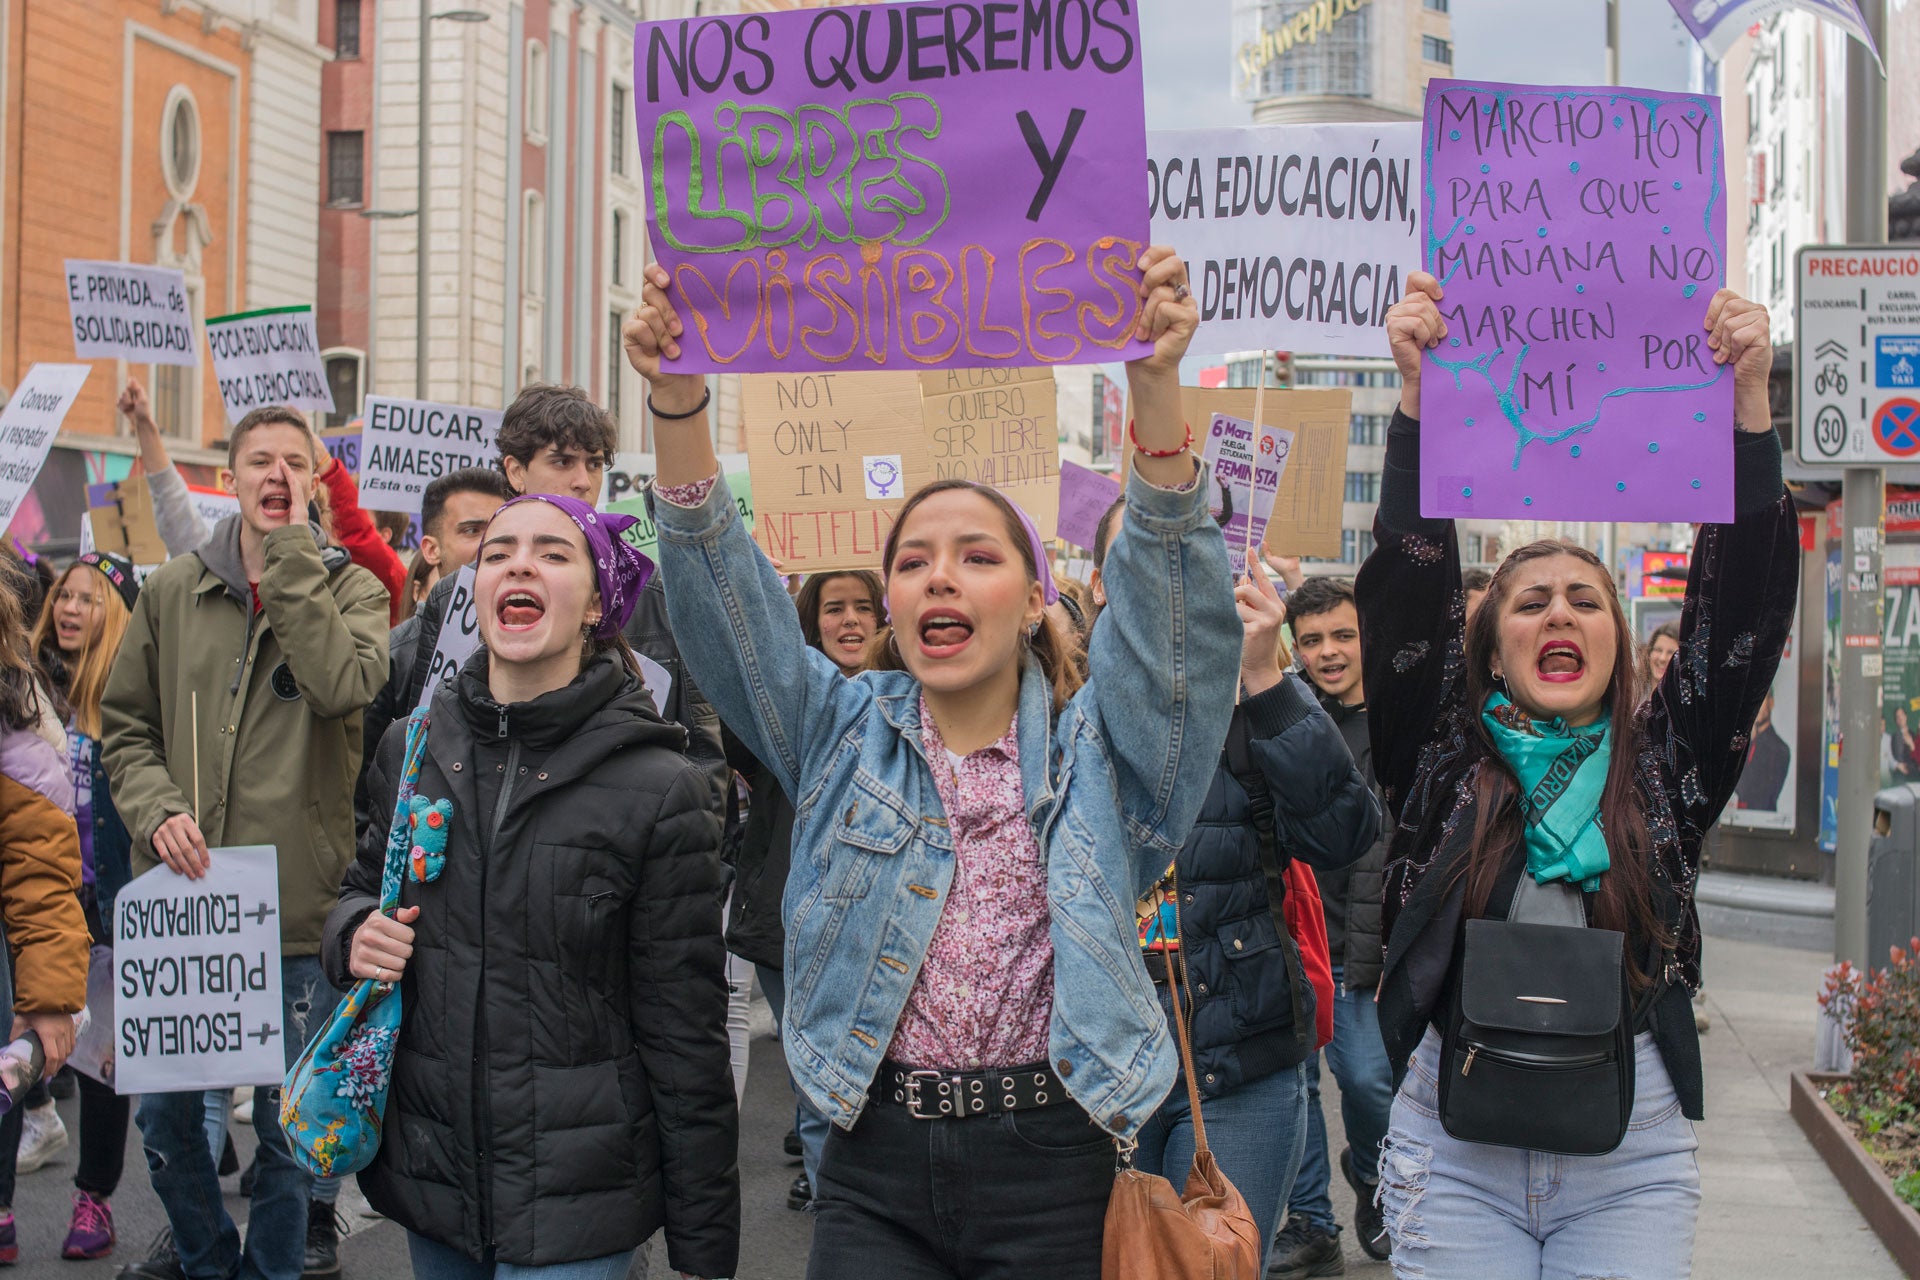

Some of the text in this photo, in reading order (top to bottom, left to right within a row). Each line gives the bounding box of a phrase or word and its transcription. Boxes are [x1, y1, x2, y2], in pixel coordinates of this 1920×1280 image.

[647, 0, 1134, 103] NOS QUEREMOS
[1438, 94, 1709, 175] MARCHO HOY
[1015, 107, 1087, 223] Y
[1214, 138, 1416, 238] EDUCACIÓN,
[1447, 176, 1660, 221] PARA QUE
[1438, 238, 1714, 288] MAÑANA NO
[1201, 255, 1399, 328] DEMOCRACIA
[1887, 290, 1916, 300] CARRIL
[75, 315, 192, 353] SOLIDARIDAD!
[209, 327, 247, 361] POCA
[1440, 302, 1707, 375] MARCHEN POR
[20, 386, 63, 412] Conocer
[220, 375, 256, 408] POCA
[776, 373, 836, 411] NOT
[948, 387, 1025, 422] QUIERO
[1523, 363, 1577, 417] MÍ
[7, 425, 48, 450] respetar
[371, 403, 489, 449] EDUCAR,
[774, 418, 853, 456] ONLY
[933, 415, 1047, 458] SER LIBRE
[1212, 419, 1253, 442] 6 Marz
[1221, 438, 1246, 451] HUELGA
[1821, 417, 1841, 444] 30
[362, 477, 421, 493] ¡Esta es
[795, 463, 842, 497] IN
[936, 451, 1055, 489] NO VALIENTE
[1215, 457, 1278, 487] FEMINISTA
[1531, 736, 1596, 810] MADRID
[121, 892, 241, 941] EQUIPADAS!
[121, 951, 267, 1002] PÚBLICAS
[121, 1012, 242, 1059] ESCUELAS
